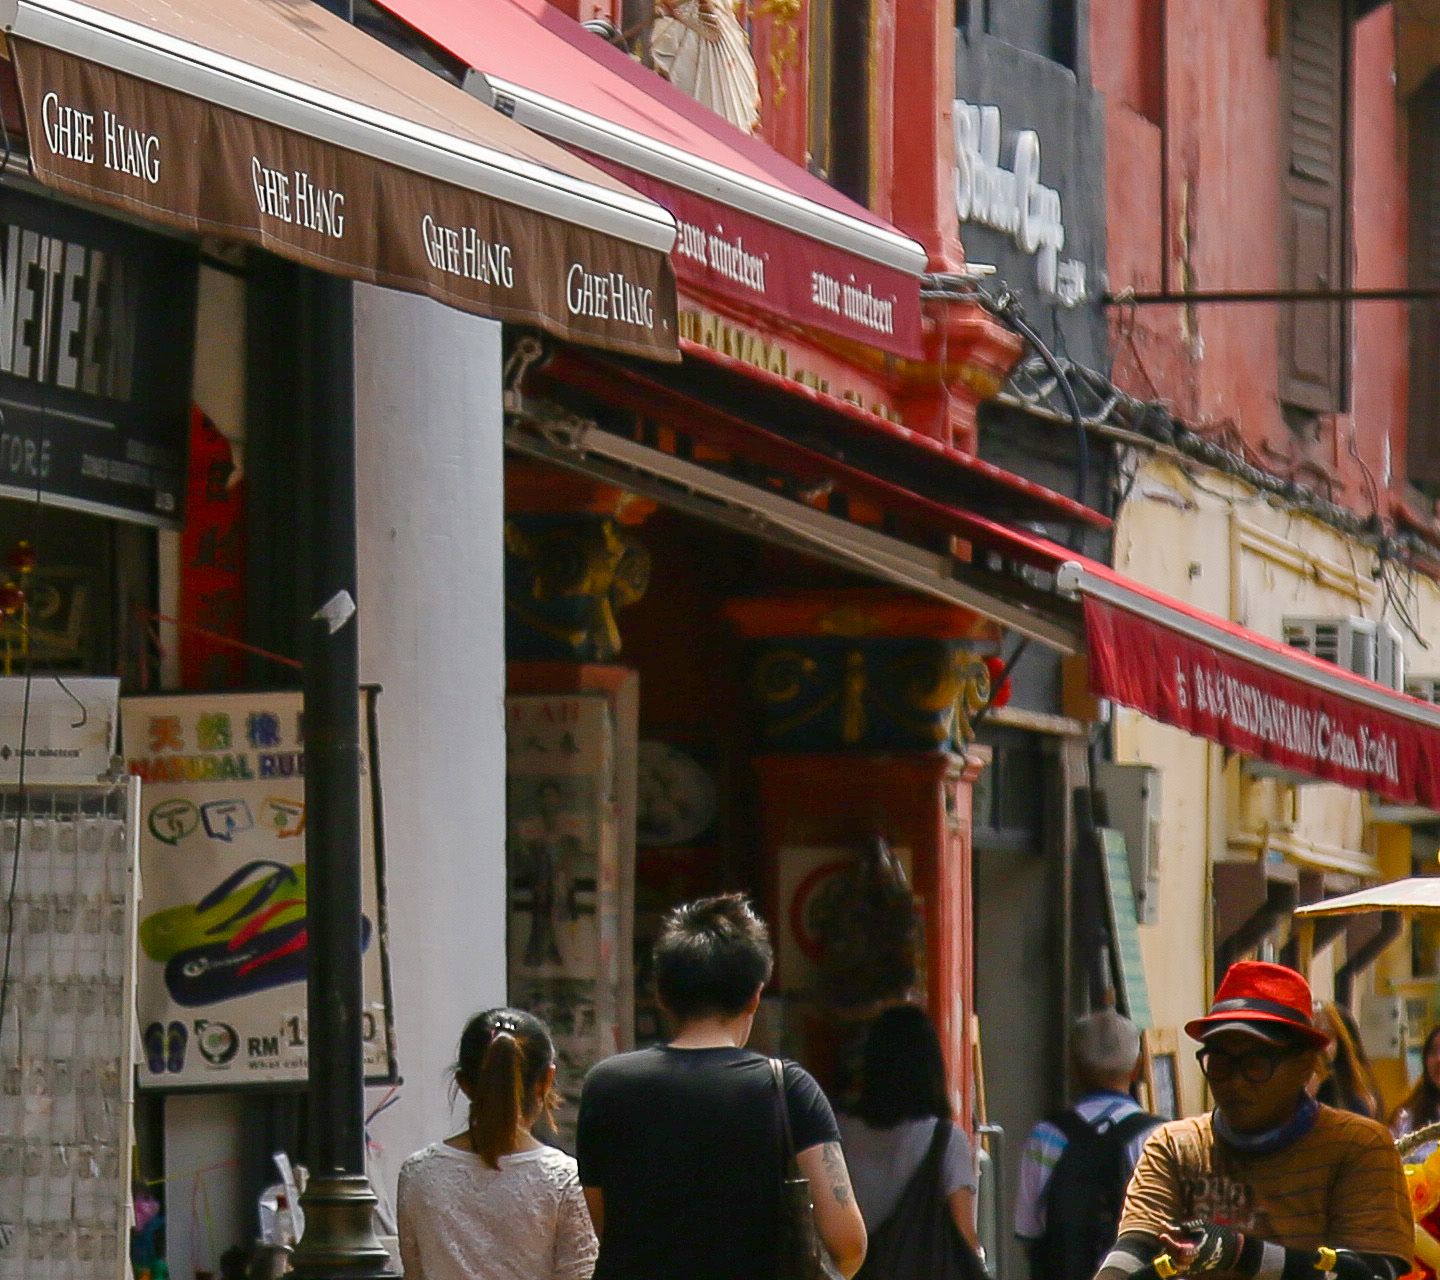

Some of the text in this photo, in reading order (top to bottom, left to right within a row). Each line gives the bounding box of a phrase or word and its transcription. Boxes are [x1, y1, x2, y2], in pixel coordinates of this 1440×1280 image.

[41, 91, 161, 185] GHEE HIANG
[294, 169, 345, 239] HIANG
[421, 214, 515, 289] GHEE HIANG
[566, 263, 609, 320] GHEE
[128, 754, 254, 783] NATURAL
[247, 1036, 279, 1057] RM
